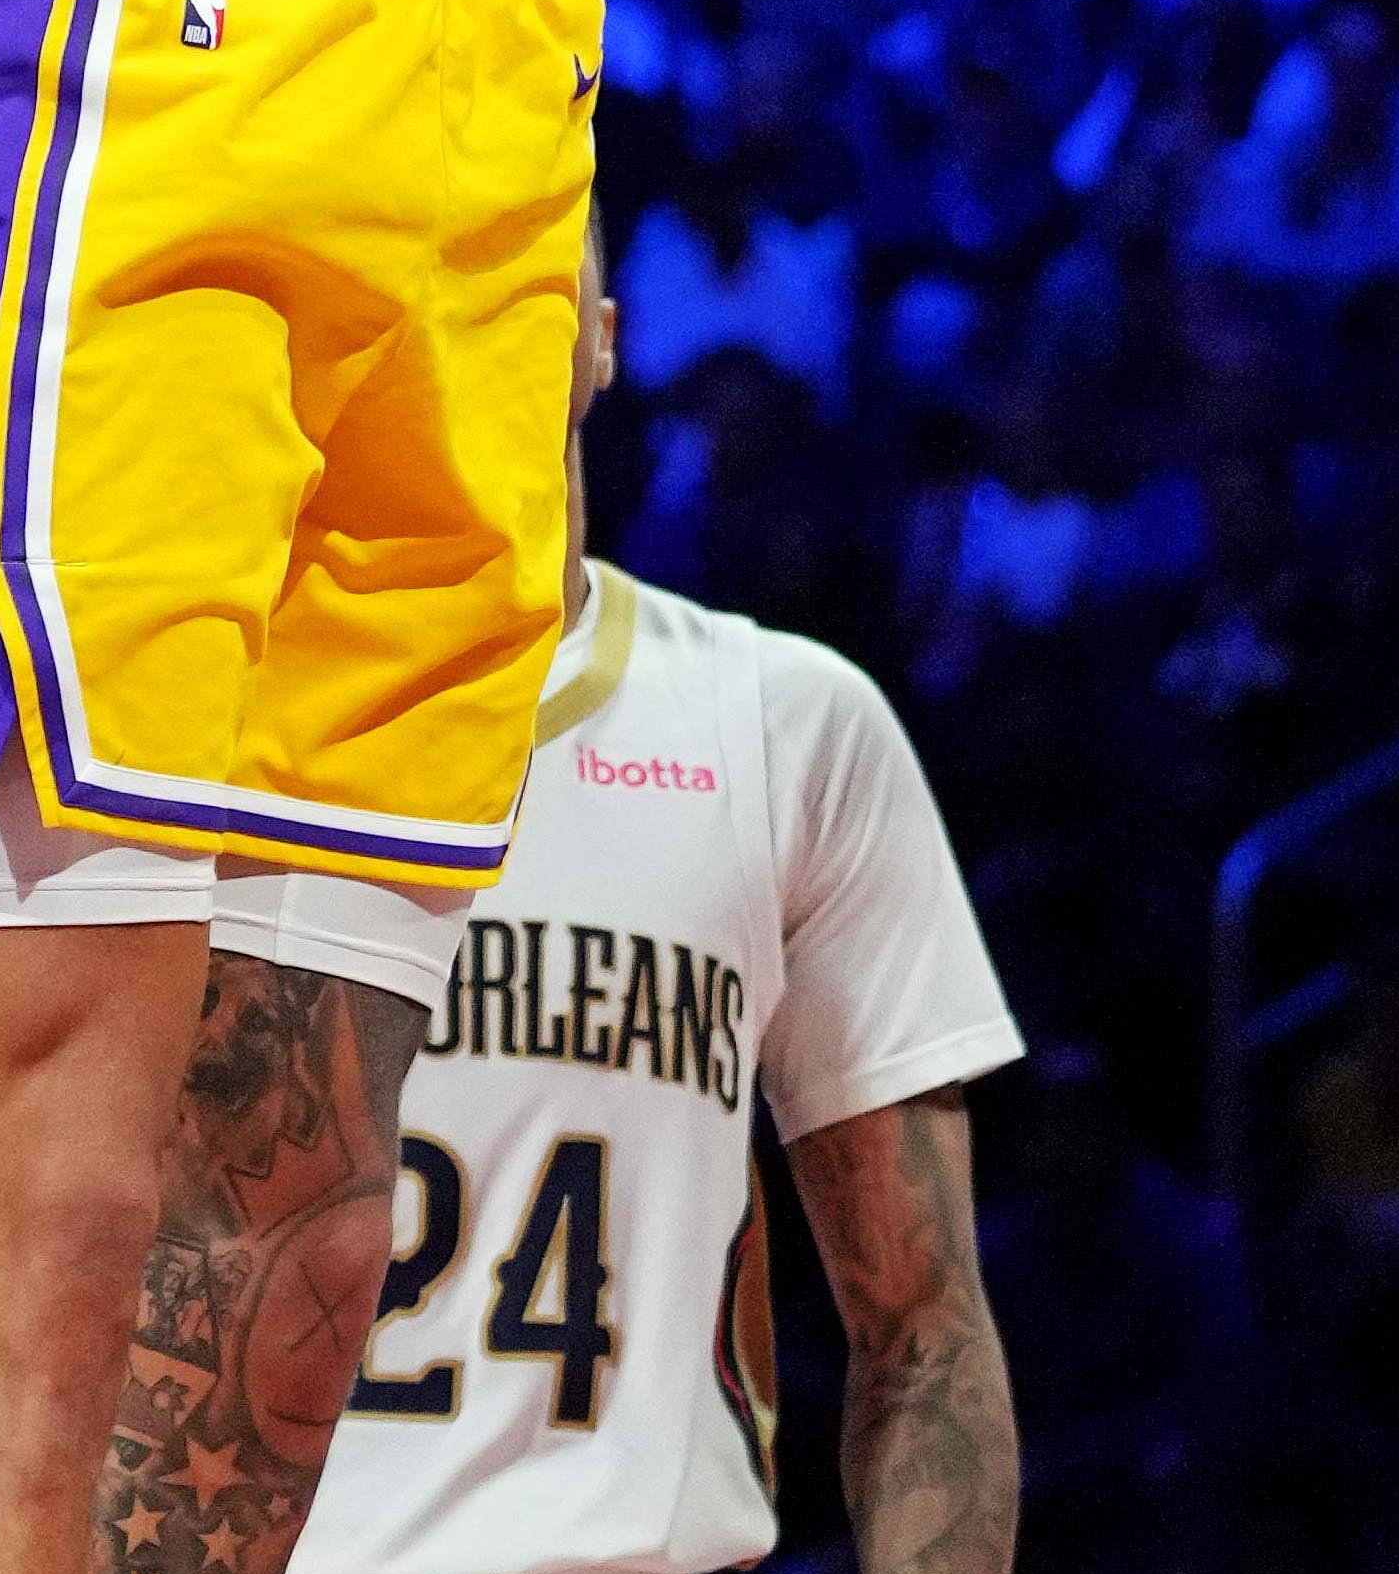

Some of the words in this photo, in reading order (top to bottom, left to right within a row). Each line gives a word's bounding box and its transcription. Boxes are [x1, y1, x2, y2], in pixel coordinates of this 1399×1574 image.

[184, 24, 208, 45] NBA
[577, 741, 716, 792] ibotta
[344, 1128, 621, 1432] 24
